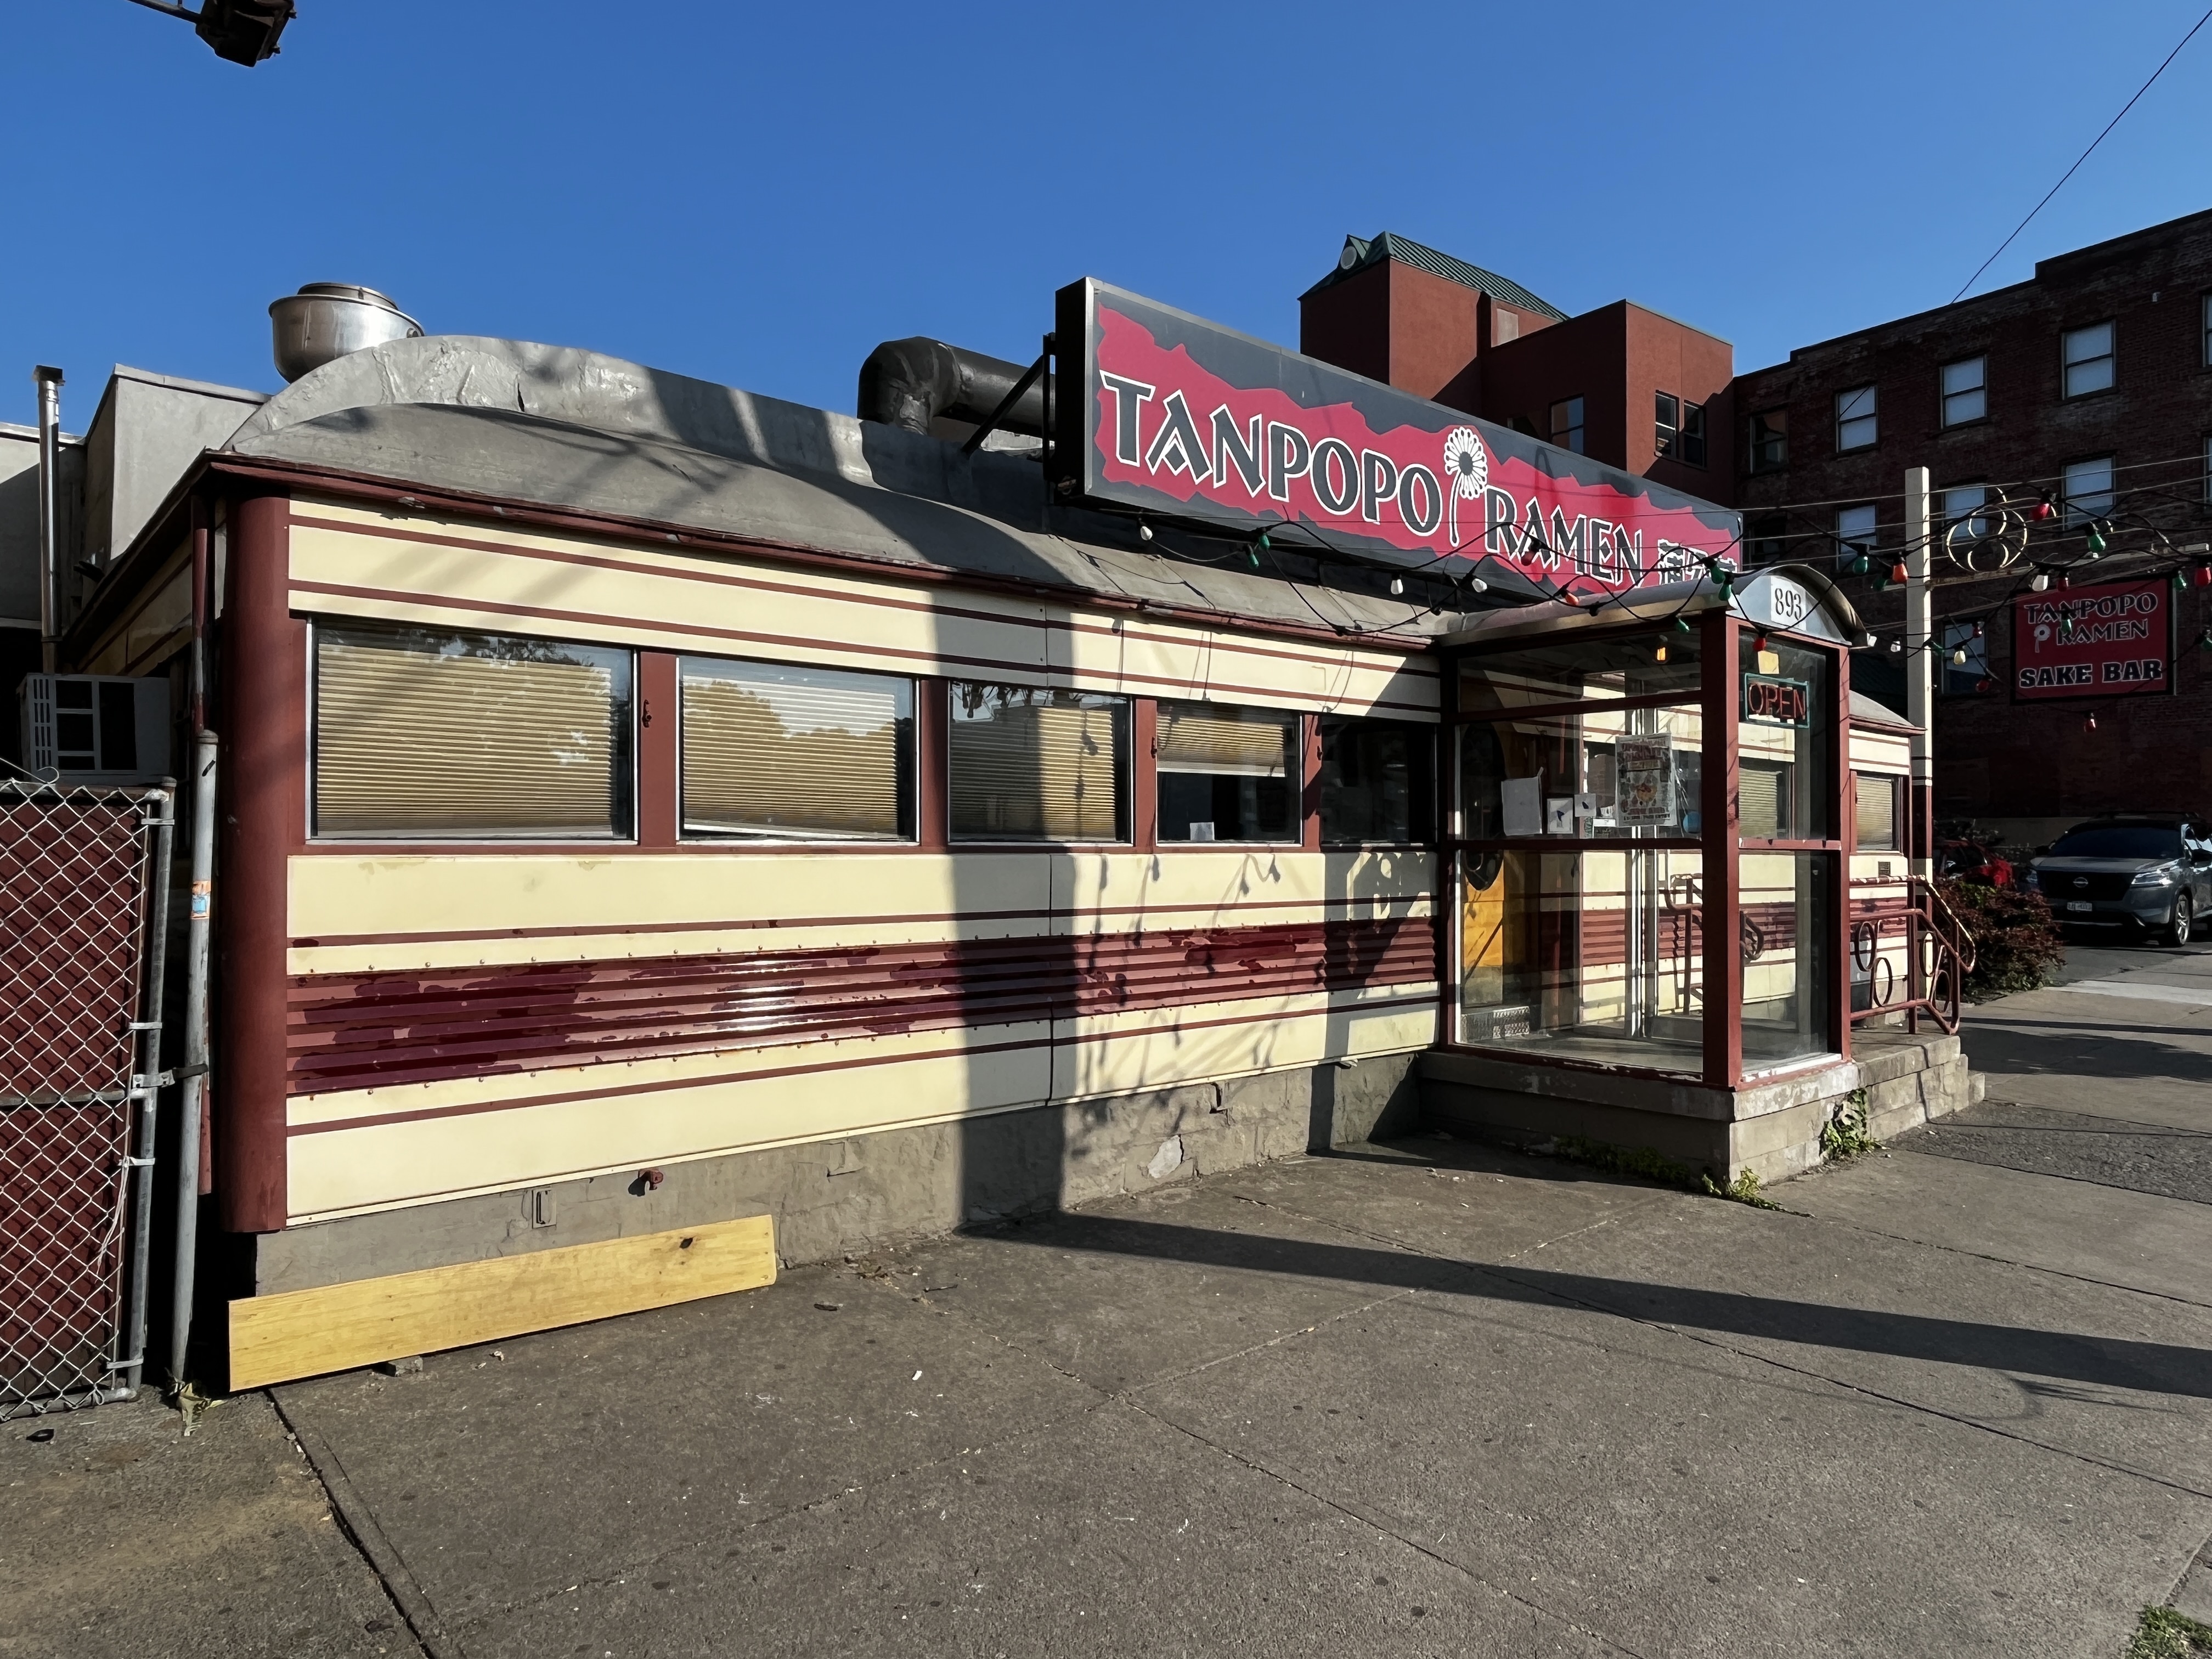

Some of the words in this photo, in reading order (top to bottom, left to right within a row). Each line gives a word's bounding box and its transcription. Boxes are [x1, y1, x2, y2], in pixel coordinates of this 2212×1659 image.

[1099, 370, 1443, 537] TANPOPO
[1485, 484, 1643, 588] RAMEN
[1775, 588, 1802, 620] 893
[2024, 592, 2158, 624] TANPOPO
[2056, 618, 2149, 646] RAMEN
[2019, 663, 2093, 689] SAKE
[2102, 659, 2163, 683] BAR
[1748, 682, 1806, 720] OPEN
